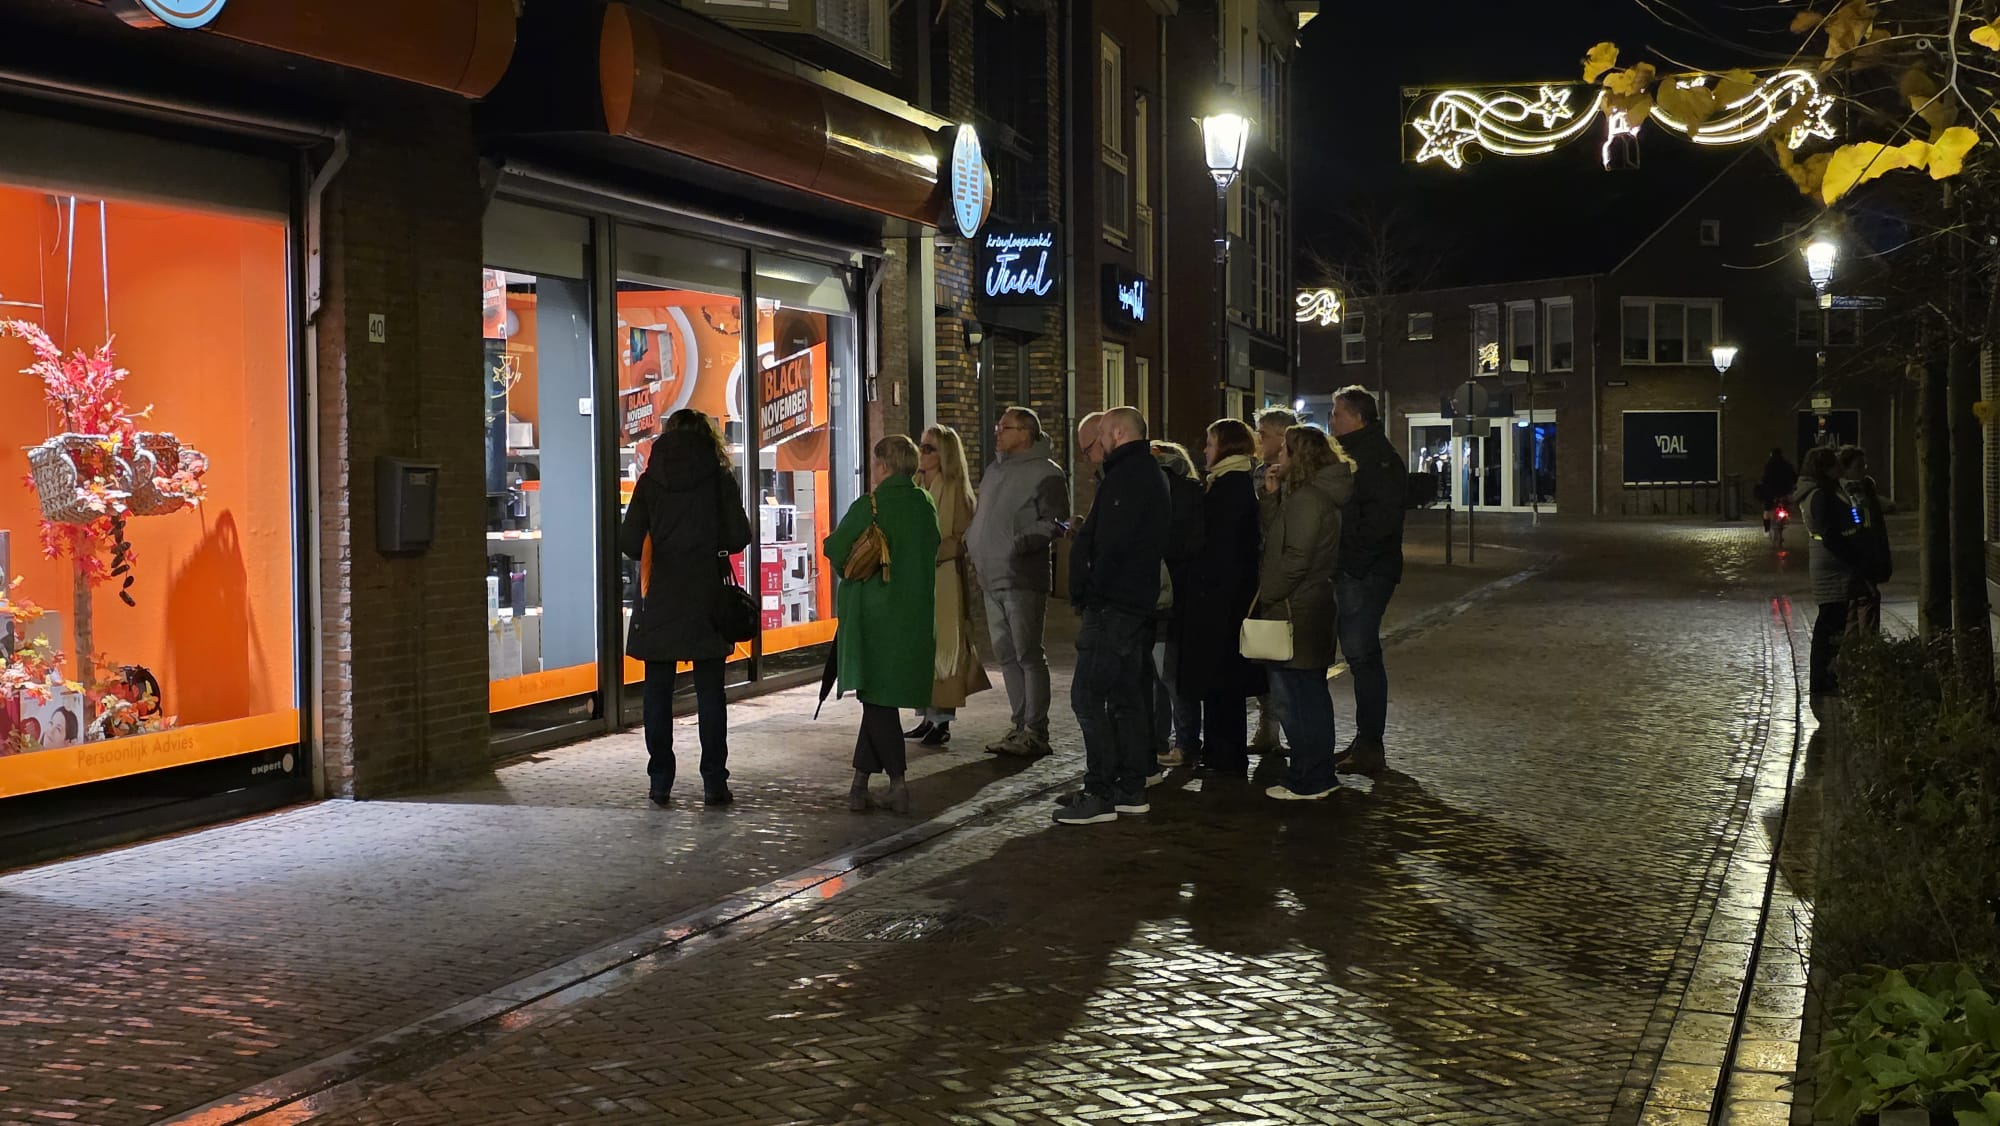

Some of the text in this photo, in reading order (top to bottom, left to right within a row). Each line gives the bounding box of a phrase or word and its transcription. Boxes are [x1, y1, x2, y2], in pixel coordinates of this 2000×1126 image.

[986, 251, 1053, 297] Juul
[371, 320, 383, 337] 40
[764, 357, 803, 402] BLACK
[628, 391, 650, 410] BLACK
[761, 390, 808, 429] NOVEMBER
[626, 404, 653, 422] NOVEMBER
[638, 414, 656, 431] DEALS
[78, 735, 195, 768] Persoonlijk Advies
[251, 760, 282, 775] expert
